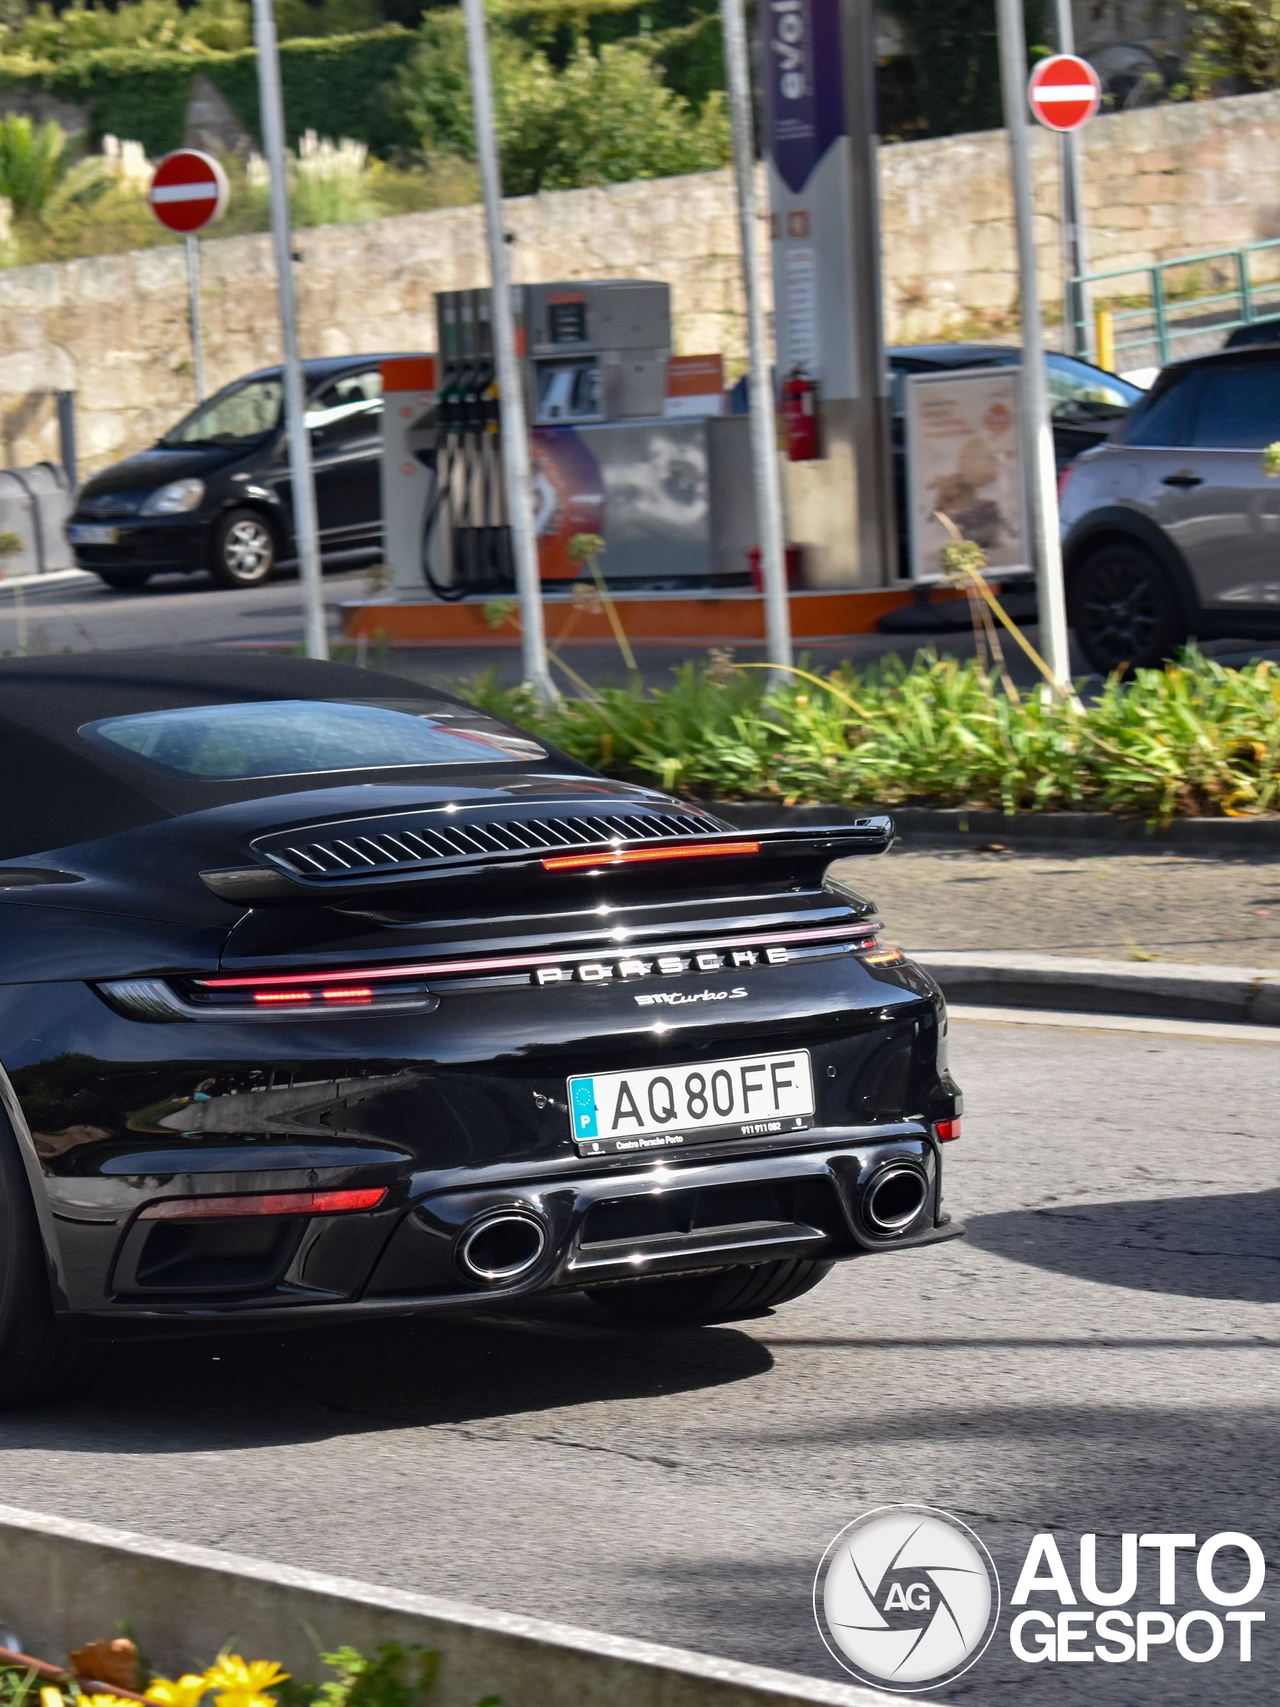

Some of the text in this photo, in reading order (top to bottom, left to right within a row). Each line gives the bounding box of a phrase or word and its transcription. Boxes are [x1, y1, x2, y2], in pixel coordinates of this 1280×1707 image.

[536, 947, 789, 985] PORSCHE
[728, 987, 748, 999] S
[580, 1114, 591, 1129] P
[741, 1125, 754, 1135] 911
[754, 1123, 768, 1133] 911
[616, 1135, 684, 1150] Centro Porsche Porto
